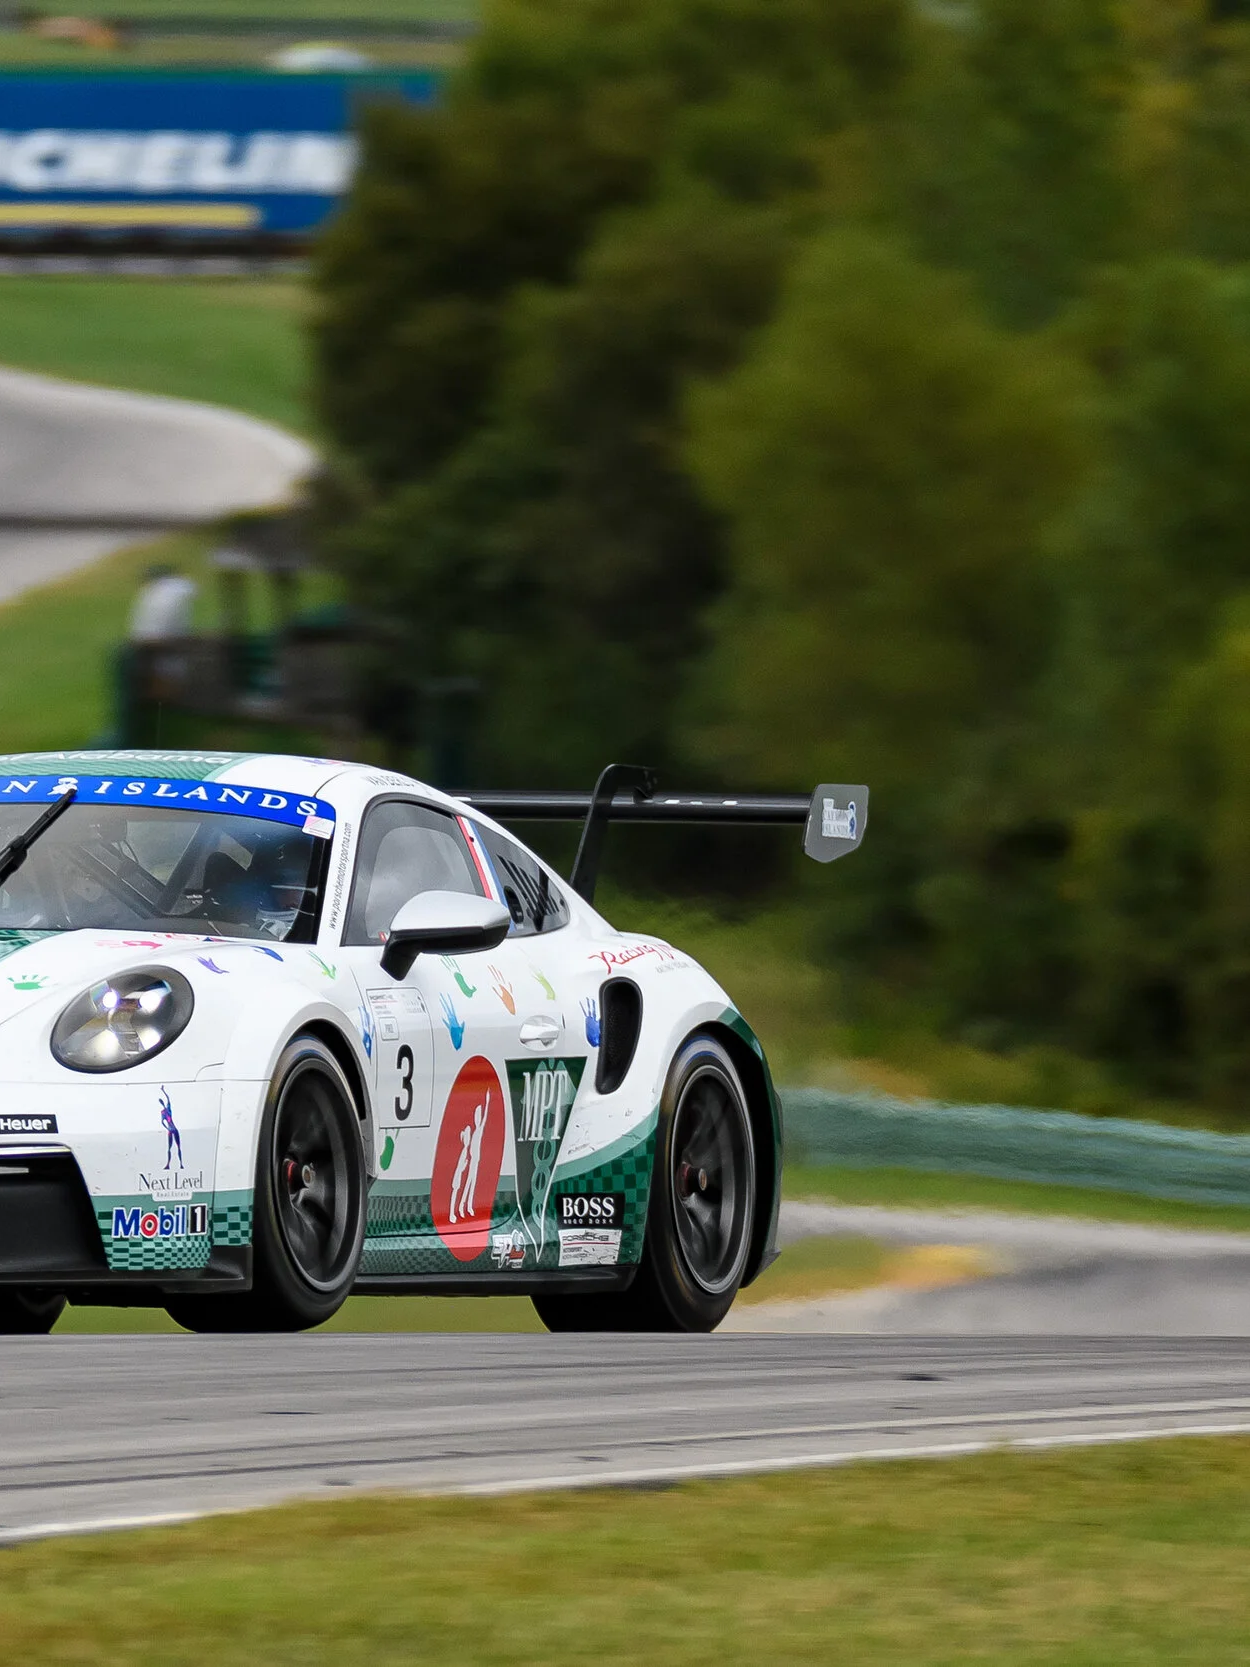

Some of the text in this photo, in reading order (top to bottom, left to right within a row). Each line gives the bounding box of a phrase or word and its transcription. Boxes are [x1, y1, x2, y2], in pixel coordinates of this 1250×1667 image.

[94, 781, 318, 816] ISLANDS
[394, 1044, 415, 1121] 3
[139, 1171, 203, 1191] Next Level
[111, 1205, 205, 1238] Mobil 1
[562, 1196, 615, 1218] BOSS
